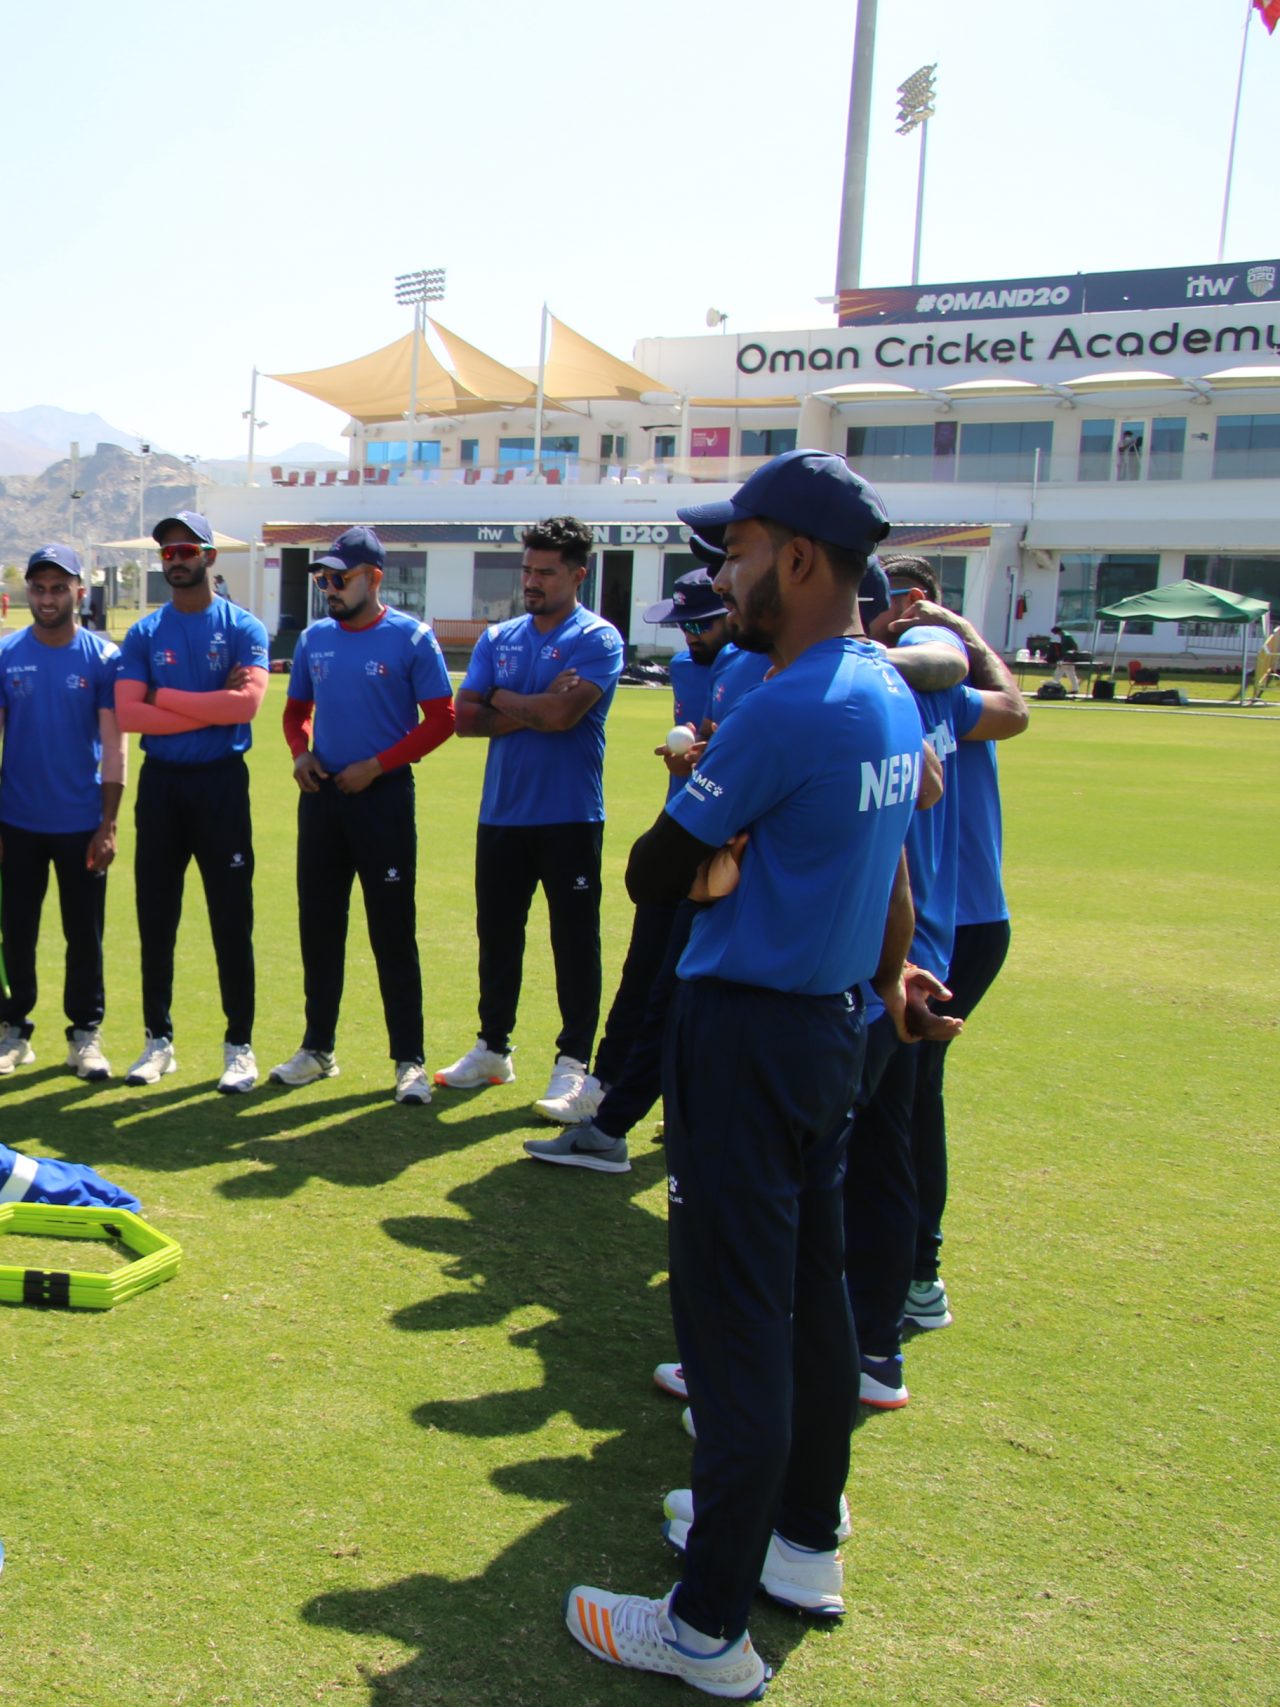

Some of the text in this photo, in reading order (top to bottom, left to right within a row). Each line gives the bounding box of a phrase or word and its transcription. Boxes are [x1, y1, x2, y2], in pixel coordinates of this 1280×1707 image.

[915, 286, 1070, 313] #OMAND20
[736, 343, 860, 374] Oman
[874, 333, 1034, 368] Cricket
[620, 525, 669, 543] D20
